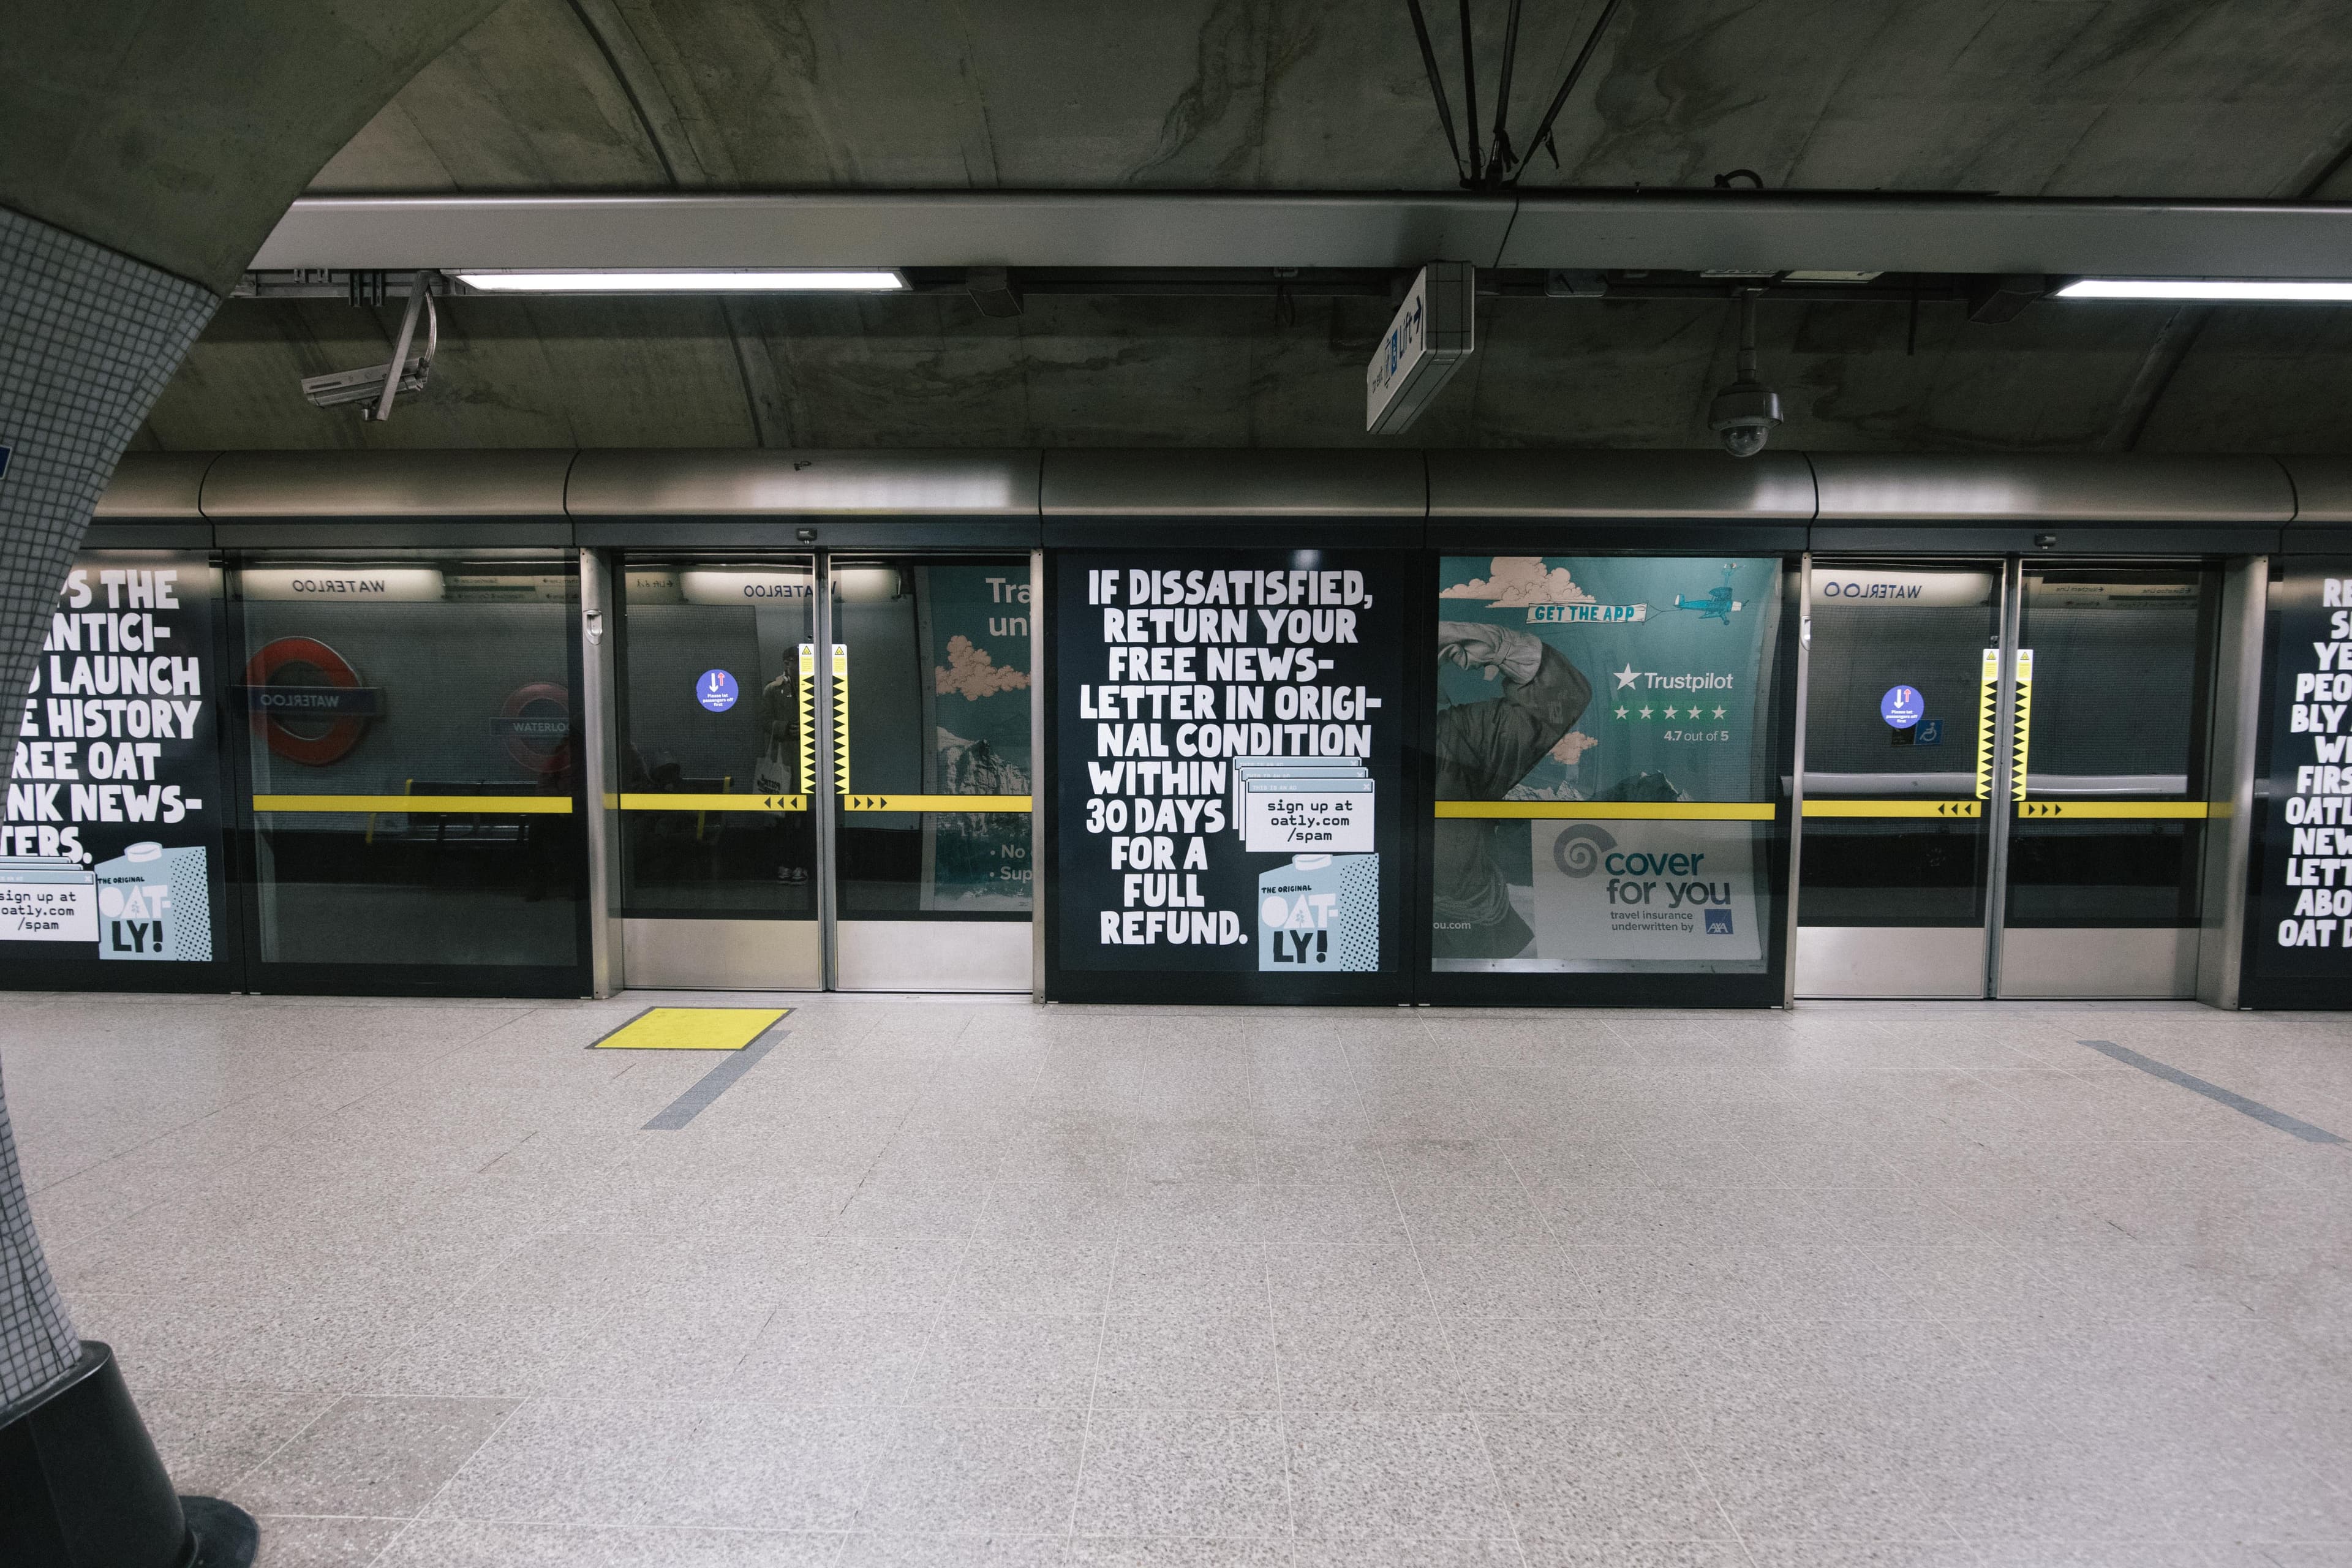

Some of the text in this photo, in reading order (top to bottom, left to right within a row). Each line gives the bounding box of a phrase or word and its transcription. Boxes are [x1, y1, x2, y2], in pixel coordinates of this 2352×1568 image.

[1400, 312, 1412, 360] Lift
[100, 569, 179, 609] THE
[986, 578, 1031, 603] Tra
[1088, 569, 1373, 609] IF DISSATISFIED,
[989, 613, 1031, 636] un
[1104, 608, 1359, 644] RETURN YOUR
[1535, 606, 1635, 622] GET THE APP
[2331, 611, 2352, 639] S
[50, 655, 201, 696] LAUNCH
[1109, 646, 1334, 682] FREE NEWS-
[1644, 673, 1733, 693] Trustpilot
[2295, 673, 2352, 702] PEO
[1080, 684, 1382, 721] LETTER IN ORIGI-
[47, 698, 202, 739] HISTORY
[2290, 704, 2348, 733] BLY
[1098, 723, 1371, 758] NAL CONDITION
[1664, 731, 1729, 741] 4.7 out of 5
[88, 741, 162, 780] OAT
[1087, 761, 1226, 796] WITHIN
[2296, 765, 2352, 794] FIRS
[70, 784, 202, 823] NEWS-
[1086, 798, 1226, 834] 30 DAYS
[1267, 799, 1353, 813] sign up at
[2285, 796, 2352, 825] OATL
[1271, 815, 1350, 828] oatly.com
[1287, 827, 1332, 843] /spam
[1001, 845, 1026, 858] No
[1111, 835, 1208, 870] FOR A
[1605, 853, 1705, 876] cover
[1000, 866, 1033, 884] Sup
[37, 894, 53, 905] up
[60, 892, 76, 902] at
[1124, 873, 1205, 907] FULL
[1606, 878, 1731, 908] for you
[2293, 889, 2352, 917] ABO
[2, 905, 75, 917] oatly.com
[17, 917, 59, 932] /spam
[1610, 911, 1693, 919] travel insurance
[111, 920, 163, 953] LY!
[1100, 910, 1248, 946] REFUND.
[1611, 922, 1694, 933] underwritten by
[1707, 922, 1728, 933] AXA
[2278, 919, 2337, 947] OAT
[1273, 930, 1328, 963] LY!
